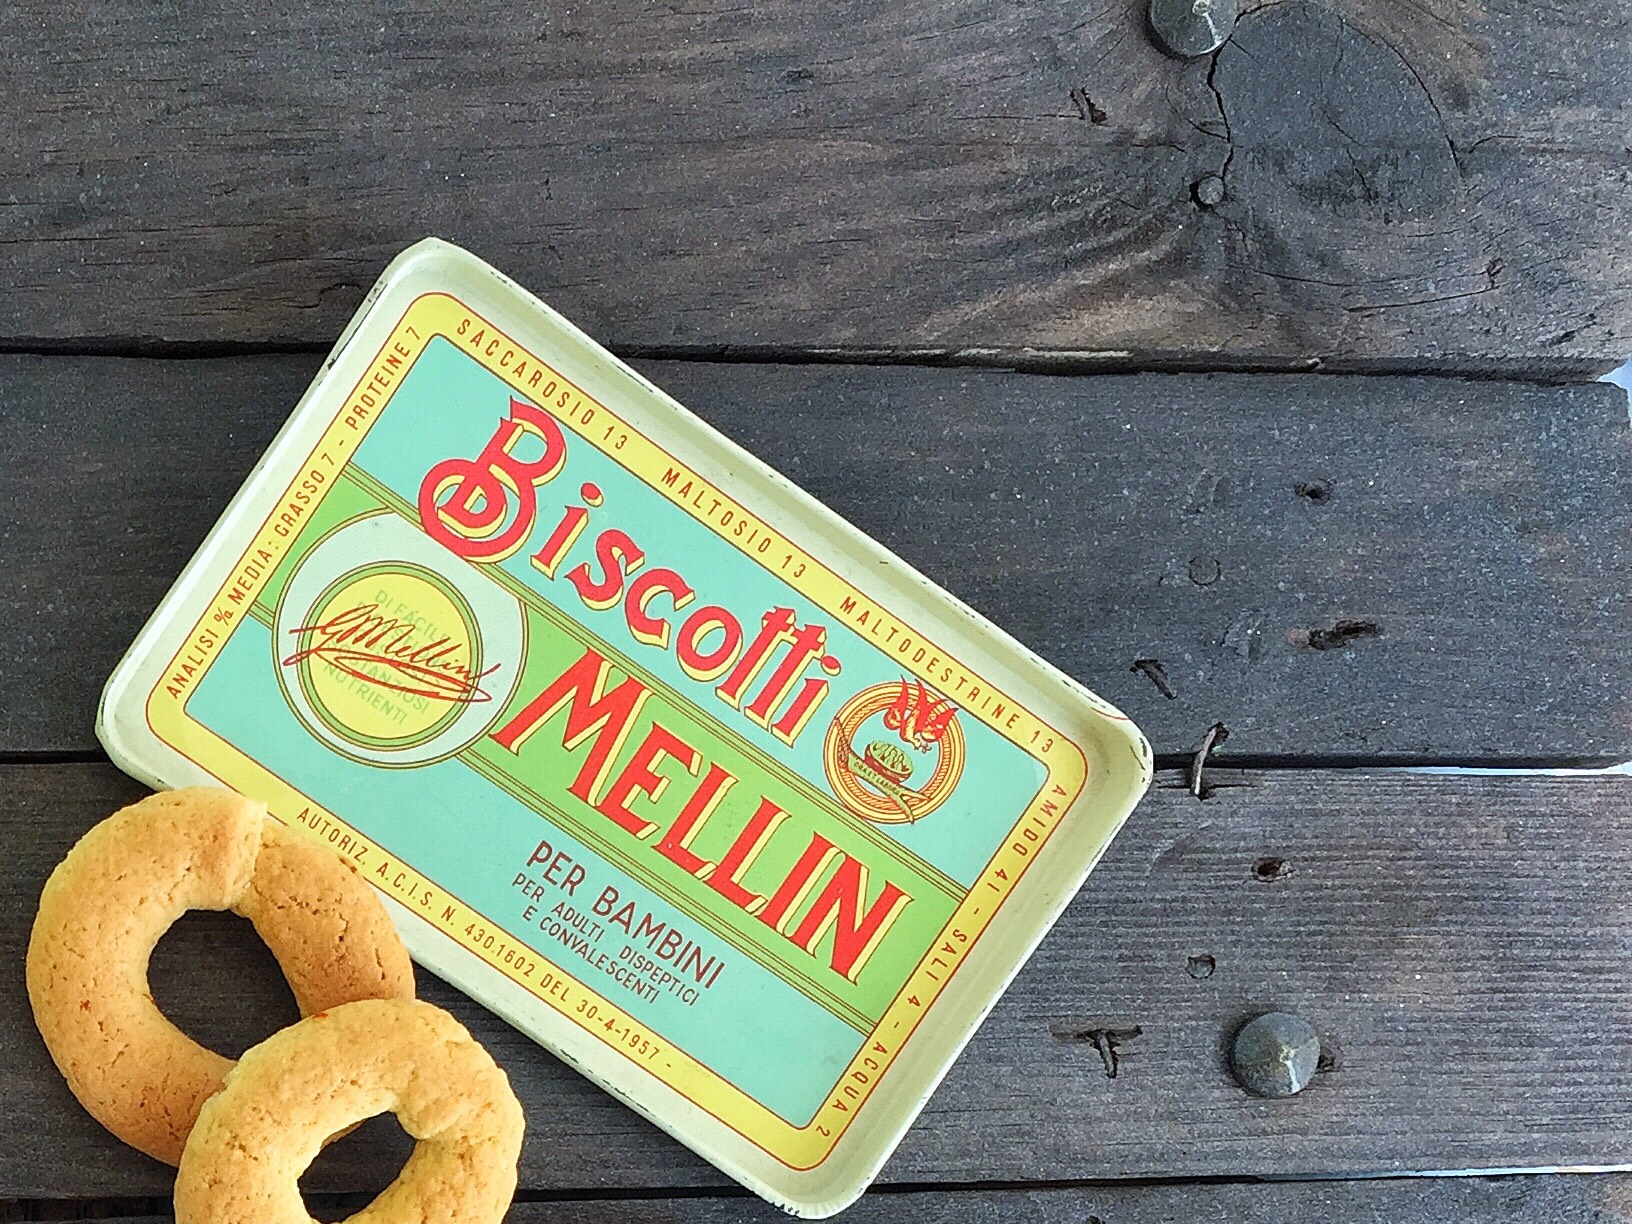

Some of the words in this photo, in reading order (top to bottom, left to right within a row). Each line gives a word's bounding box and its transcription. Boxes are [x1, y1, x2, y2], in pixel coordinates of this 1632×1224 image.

[166, 629, 218, 699] ANALISI
[274, 470, 324, 537] GRASSO
[321, 453, 334, 466] 7
[345, 342, 410, 430] PROTEINE
[405, 326, 420, 340] 7
[457, 319, 594, 425] SACCAROSIO
[604, 426, 627, 449] 13
[661, 467, 771, 552] MALTOSIO
[782, 555, 806, 578] 13
[840, 596, 1020, 729] MALTODESTRINE
[1031, 730, 1053, 752] 13
[372, 587, 394, 610] DI
[418, 396, 842, 748] Biscotti
[321, 660, 409, 727] NUTRIENTI
[489, 647, 915, 985] MELLIN
[1013, 785, 1066, 856] AMIDO
[297, 808, 368, 865] AUTORIZ.
[376, 862, 432, 910] A.C.I.S.
[441, 906, 456, 925] N.
[465, 924, 535, 977] 430.1602
[540, 974, 569, 1002] DEL
[577, 1000, 659, 1059] 30-4-1957
[512, 873, 545, 903] PER
[551, 902, 604, 942] ADULTI
[619, 945, 699, 1006] DISPEPTICI
[523, 906, 538, 921] E
[540, 917, 660, 1003] CONVALESCENTI
[527, 840, 585, 896] PER
[592, 886, 725, 989] BAMBINI
[926, 929, 967, 981] SALI
[908, 995, 920, 1006] 4
[832, 1042, 887, 1111] ACQUA
[816, 1125, 830, 1137] 2
